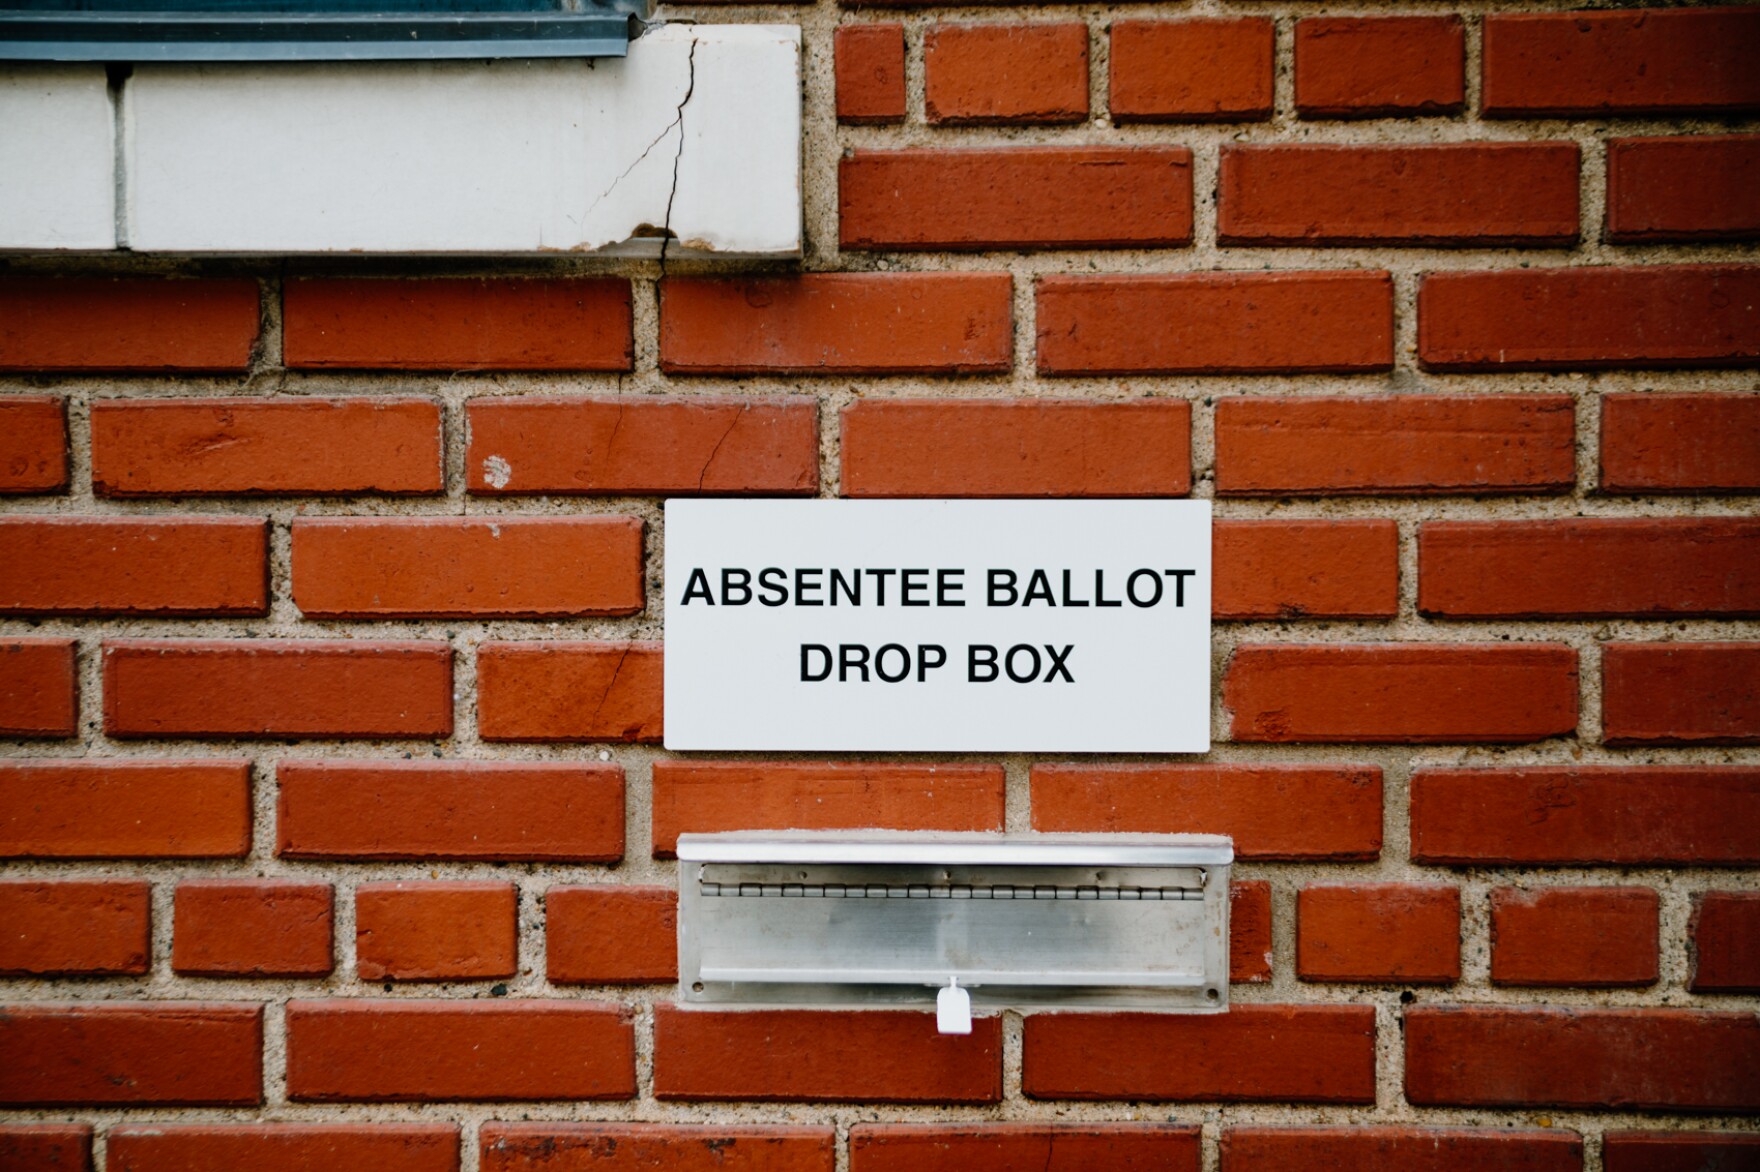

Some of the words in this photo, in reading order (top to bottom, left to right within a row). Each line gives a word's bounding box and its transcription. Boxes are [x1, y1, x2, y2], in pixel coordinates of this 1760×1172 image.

[680, 567, 966, 607] ABSENTEE
[986, 568, 1196, 608] BALLOT
[800, 643, 947, 684] DROP
[967, 643, 1075, 684] BOX
